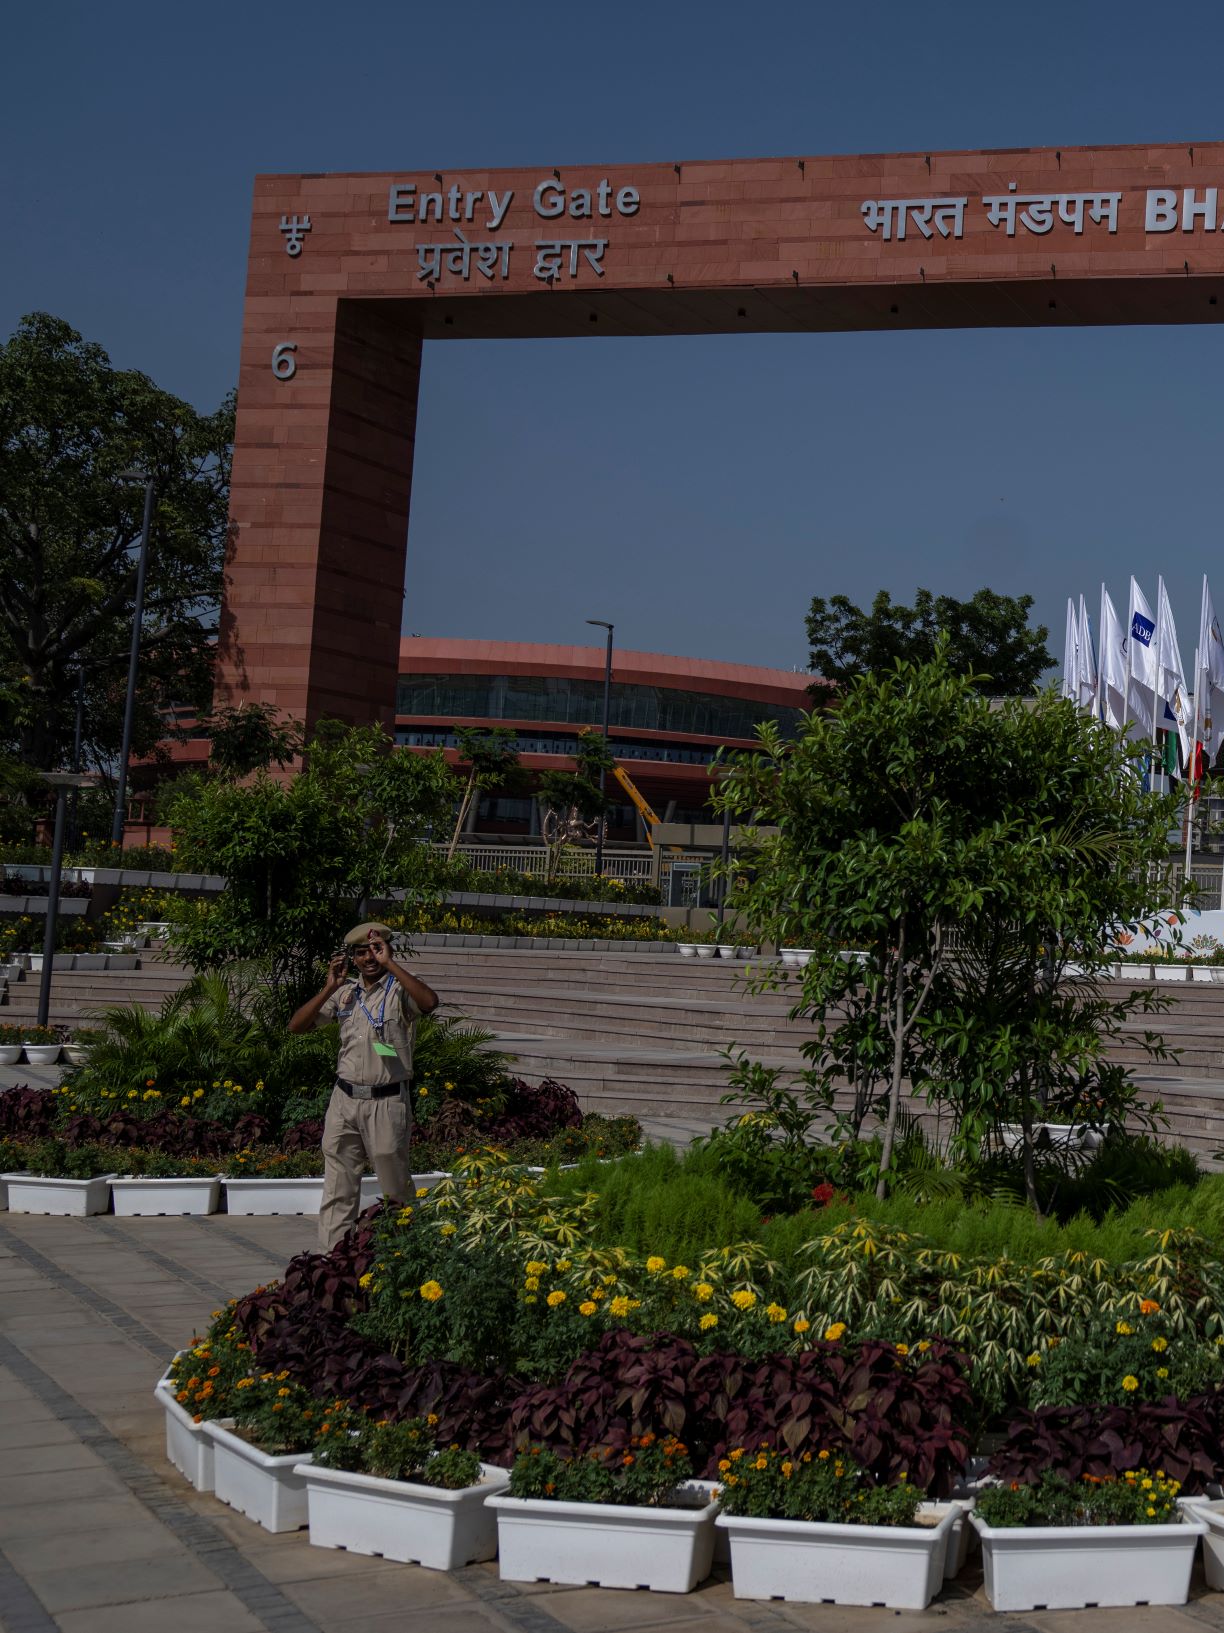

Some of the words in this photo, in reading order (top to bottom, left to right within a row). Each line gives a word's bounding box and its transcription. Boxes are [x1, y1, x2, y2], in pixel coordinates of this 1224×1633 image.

[387, 183, 514, 230] Entry
[533, 178, 640, 218] Gate
[860, 196, 968, 241] भारत
[982, 182, 1122, 235] मंडपम
[416, 227, 513, 280] प्रवेश
[533, 239, 609, 281] द्वार
[271, 341, 297, 380] 6
[1131, 622, 1151, 641] ADB
